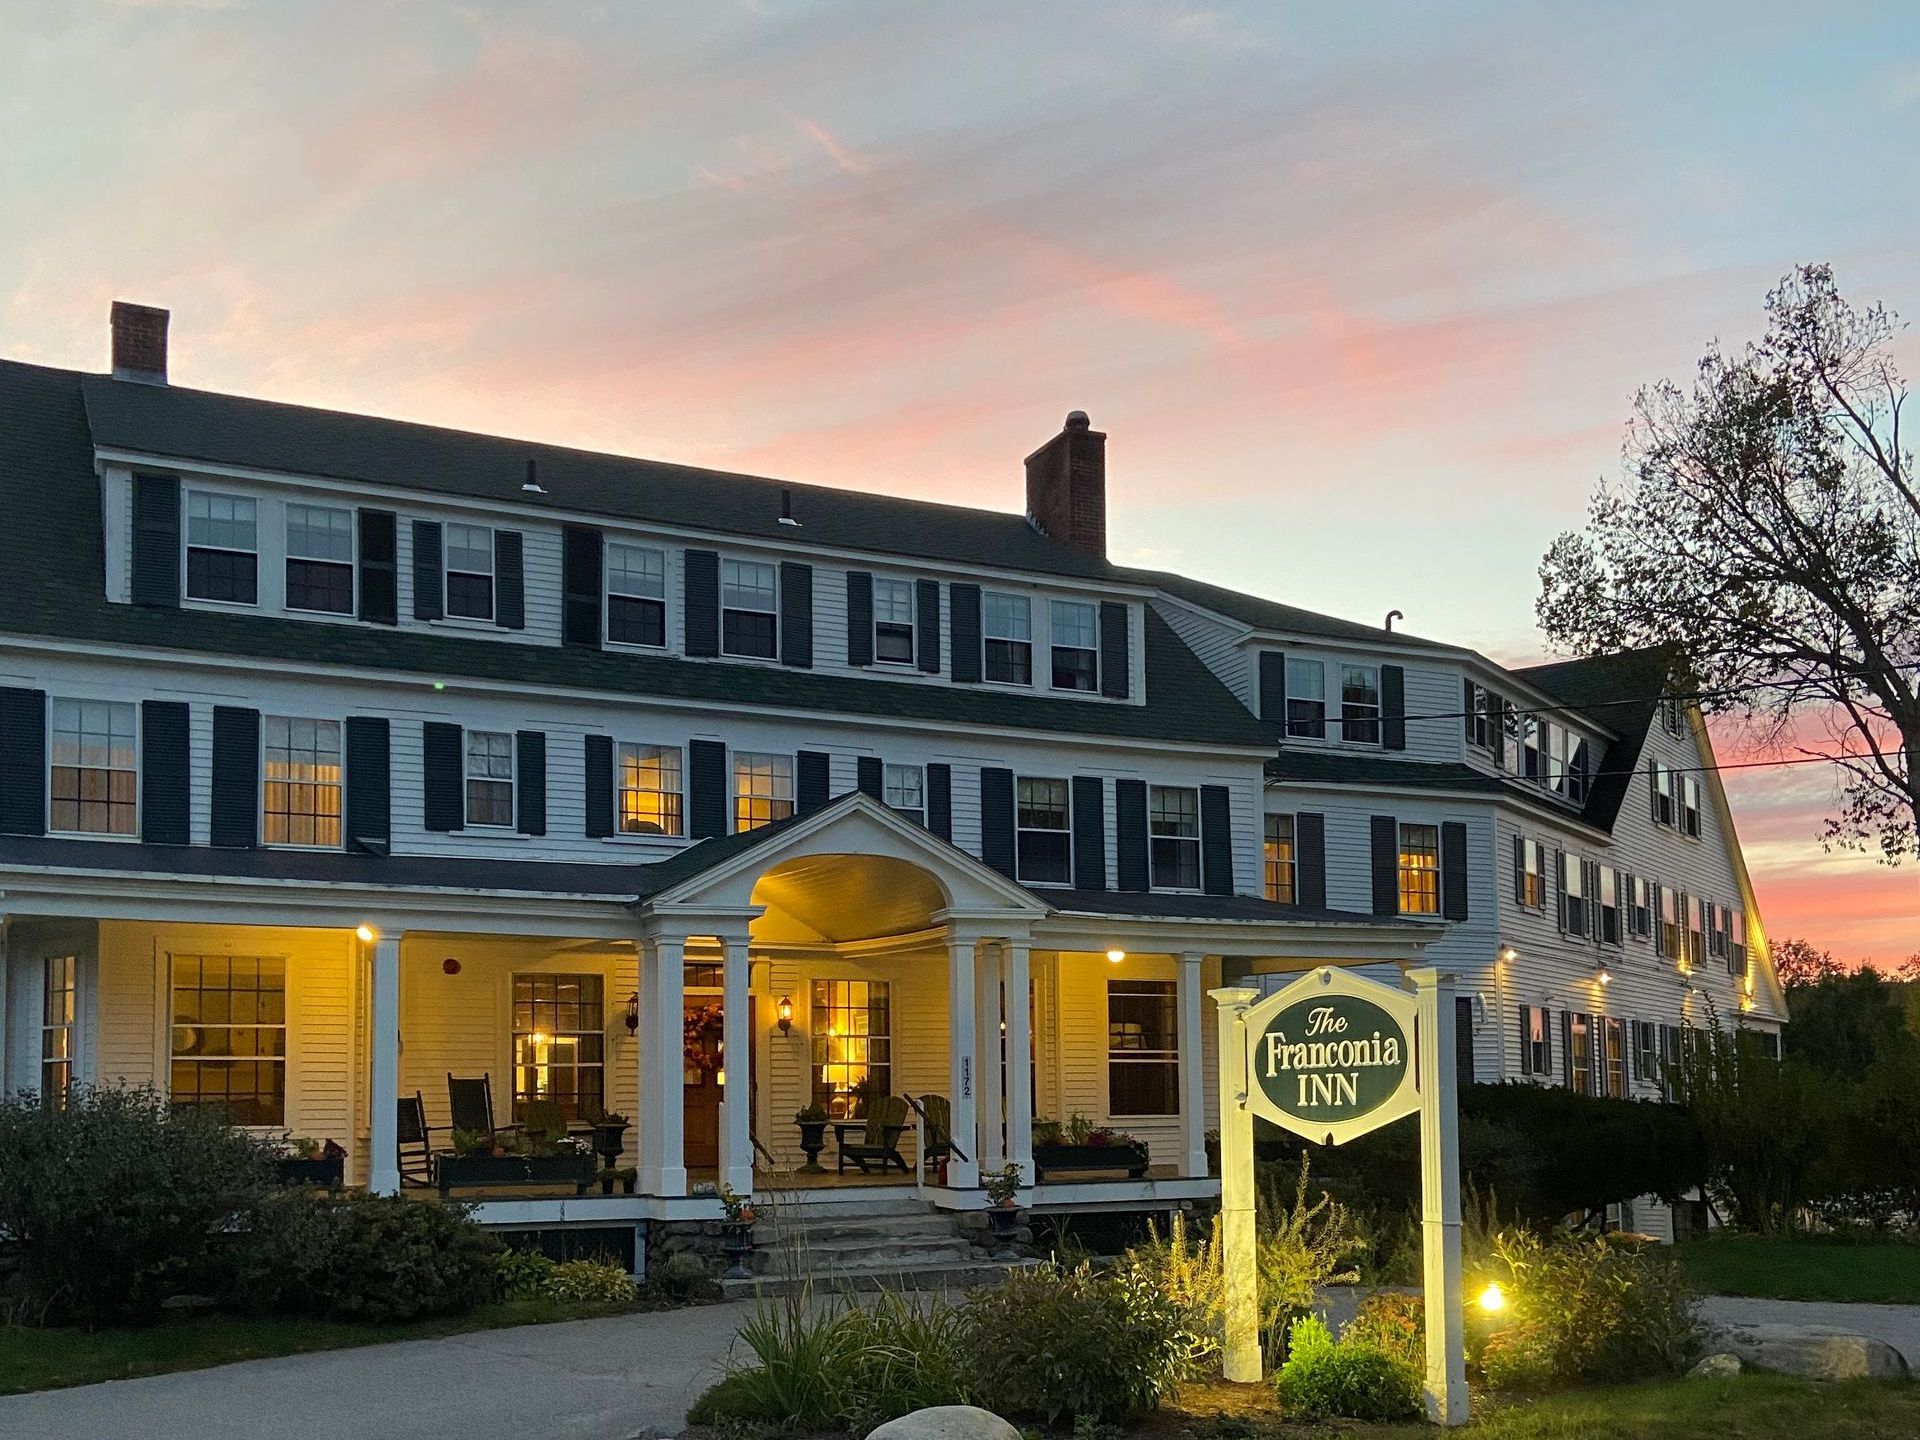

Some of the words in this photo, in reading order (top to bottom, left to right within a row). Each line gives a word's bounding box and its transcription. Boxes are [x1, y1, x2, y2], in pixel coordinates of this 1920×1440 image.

[1305, 1007, 1348, 1036] The
[1265, 1031, 1401, 1077] Franconia
[1297, 1072, 1358, 1107] INN
